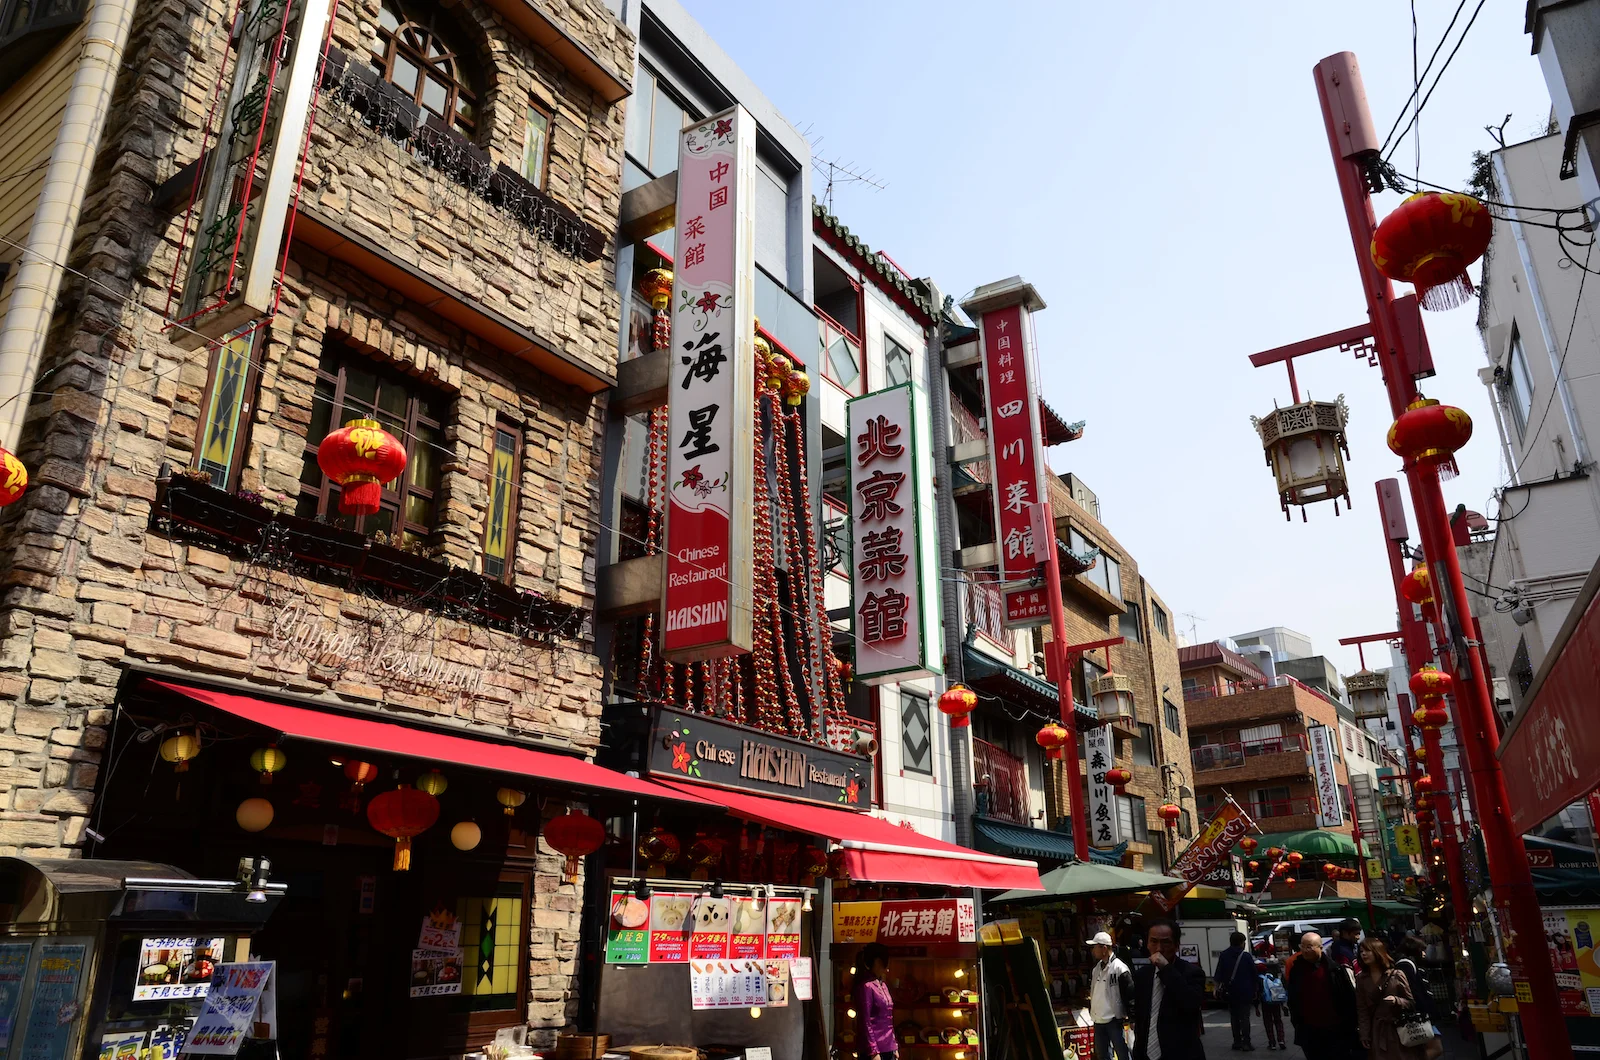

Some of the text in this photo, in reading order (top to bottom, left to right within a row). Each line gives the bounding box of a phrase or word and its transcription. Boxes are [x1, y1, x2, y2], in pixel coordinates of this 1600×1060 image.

[684, 161, 730, 270] 中国 菜館
[995, 319, 1016, 384] 中国料理
[679, 331, 728, 461] 海星
[996, 398, 1036, 561] 四川菜館
[856, 414, 910, 644] 北京菜館
[678, 543, 721, 564] Chinese
[668, 564, 728, 588] Restaurant
[666, 599, 728, 632] HAISHIN
[1009, 604, 1048, 617] 四川料理
[740, 739, 807, 789] HAISHIN
[808, 764, 847, 788] Restaurant
[1090, 750, 1113, 842] 森田川魚店
[1558, 861, 1582, 869] KOBE
[881, 908, 956, 937] 北京菜館
[692, 934, 727, 943] パンダまん
[733, 936, 760, 945] ぶたまん
[768, 935, 800, 944] 中華ちまき
